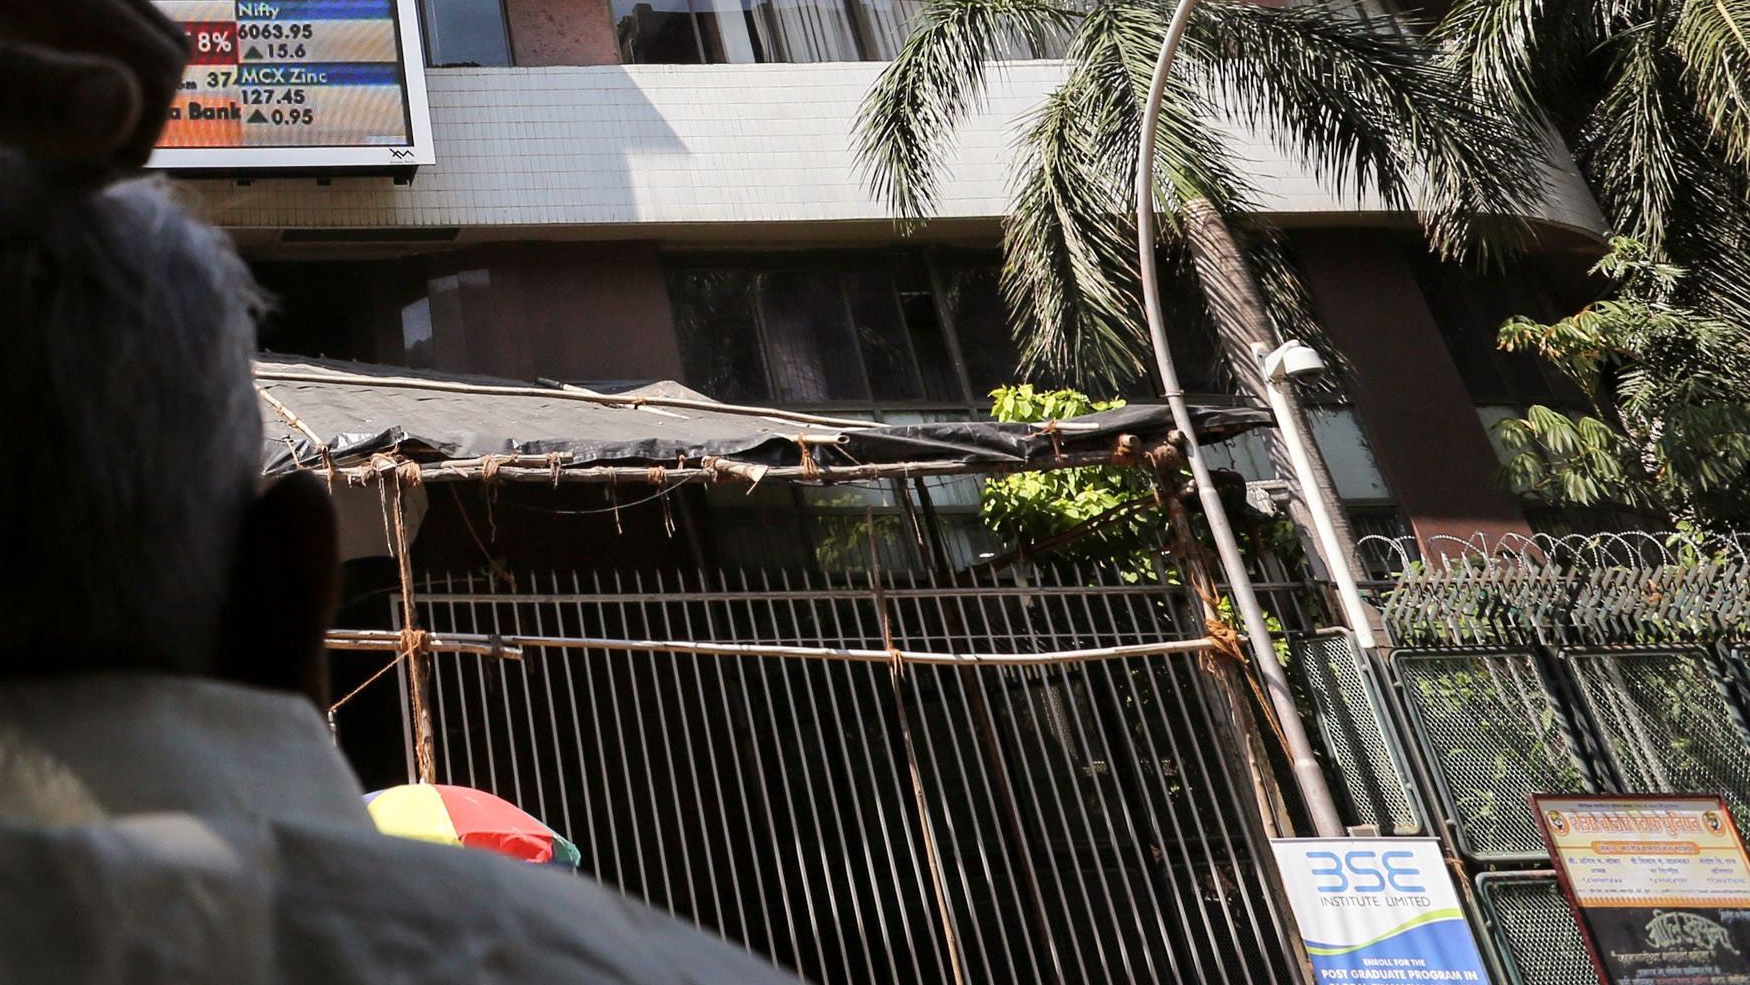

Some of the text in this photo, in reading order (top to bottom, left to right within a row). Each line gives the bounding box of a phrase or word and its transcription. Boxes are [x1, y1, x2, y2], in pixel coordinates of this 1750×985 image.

[237, 2, 280, 18] Nifty
[238, 23, 314, 39] 6063.95
[198, 31, 232, 53] 8%
[267, 44, 306, 59] 15.6
[241, 68, 328, 84] MCX Zinc
[241, 89, 306, 105] 127.45
[188, 102, 242, 120] Bank
[270, 109, 314, 125] 0.95
[1306, 851, 1426, 893] BSE
[1321, 896, 1431, 907] INSTITUTE LIMITED
[1363, 958, 1393, 966] ENROLL
[1321, 969, 1478, 981] POST GRADUATE PROGRAM IN
